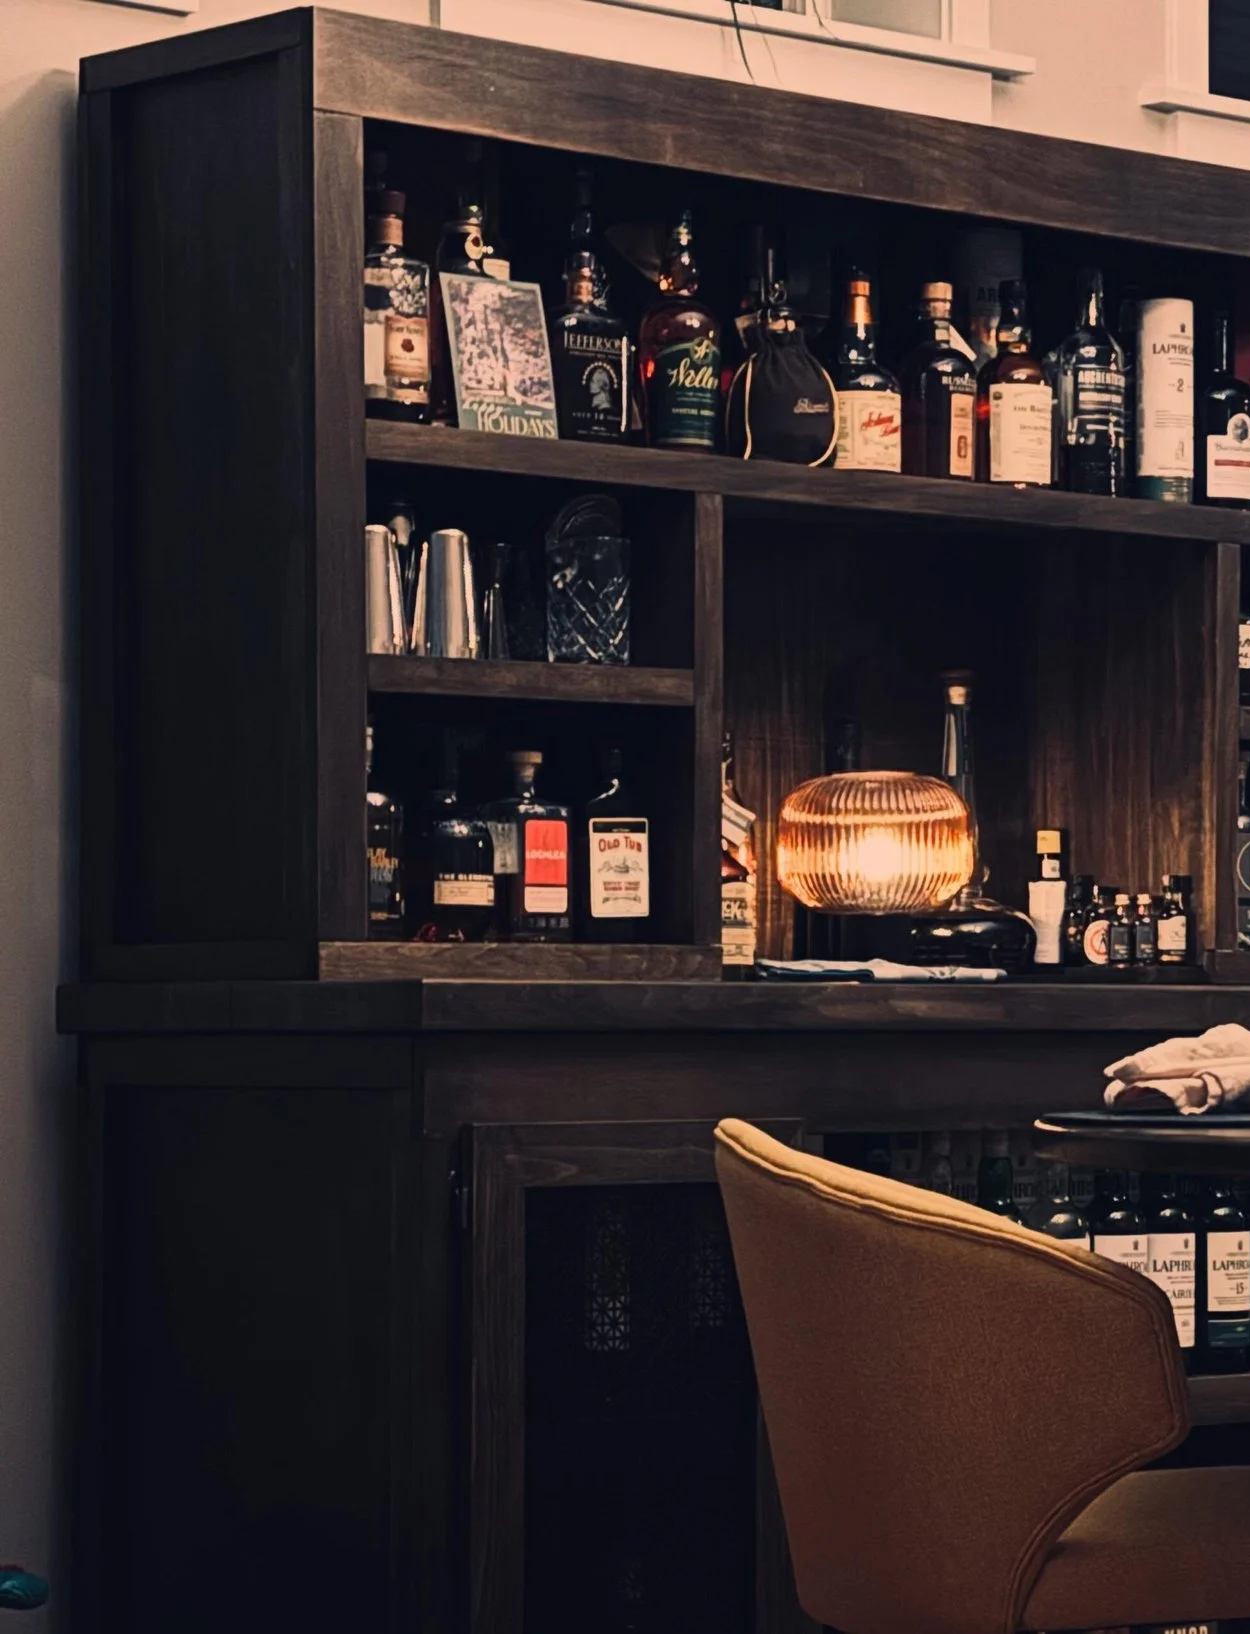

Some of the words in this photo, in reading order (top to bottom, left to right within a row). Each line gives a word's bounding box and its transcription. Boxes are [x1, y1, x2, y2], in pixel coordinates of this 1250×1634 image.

[477, 404, 556, 439] HOLIDAYS
[598, 838, 621, 853] OLD
[624, 835, 643, 853] TUB
